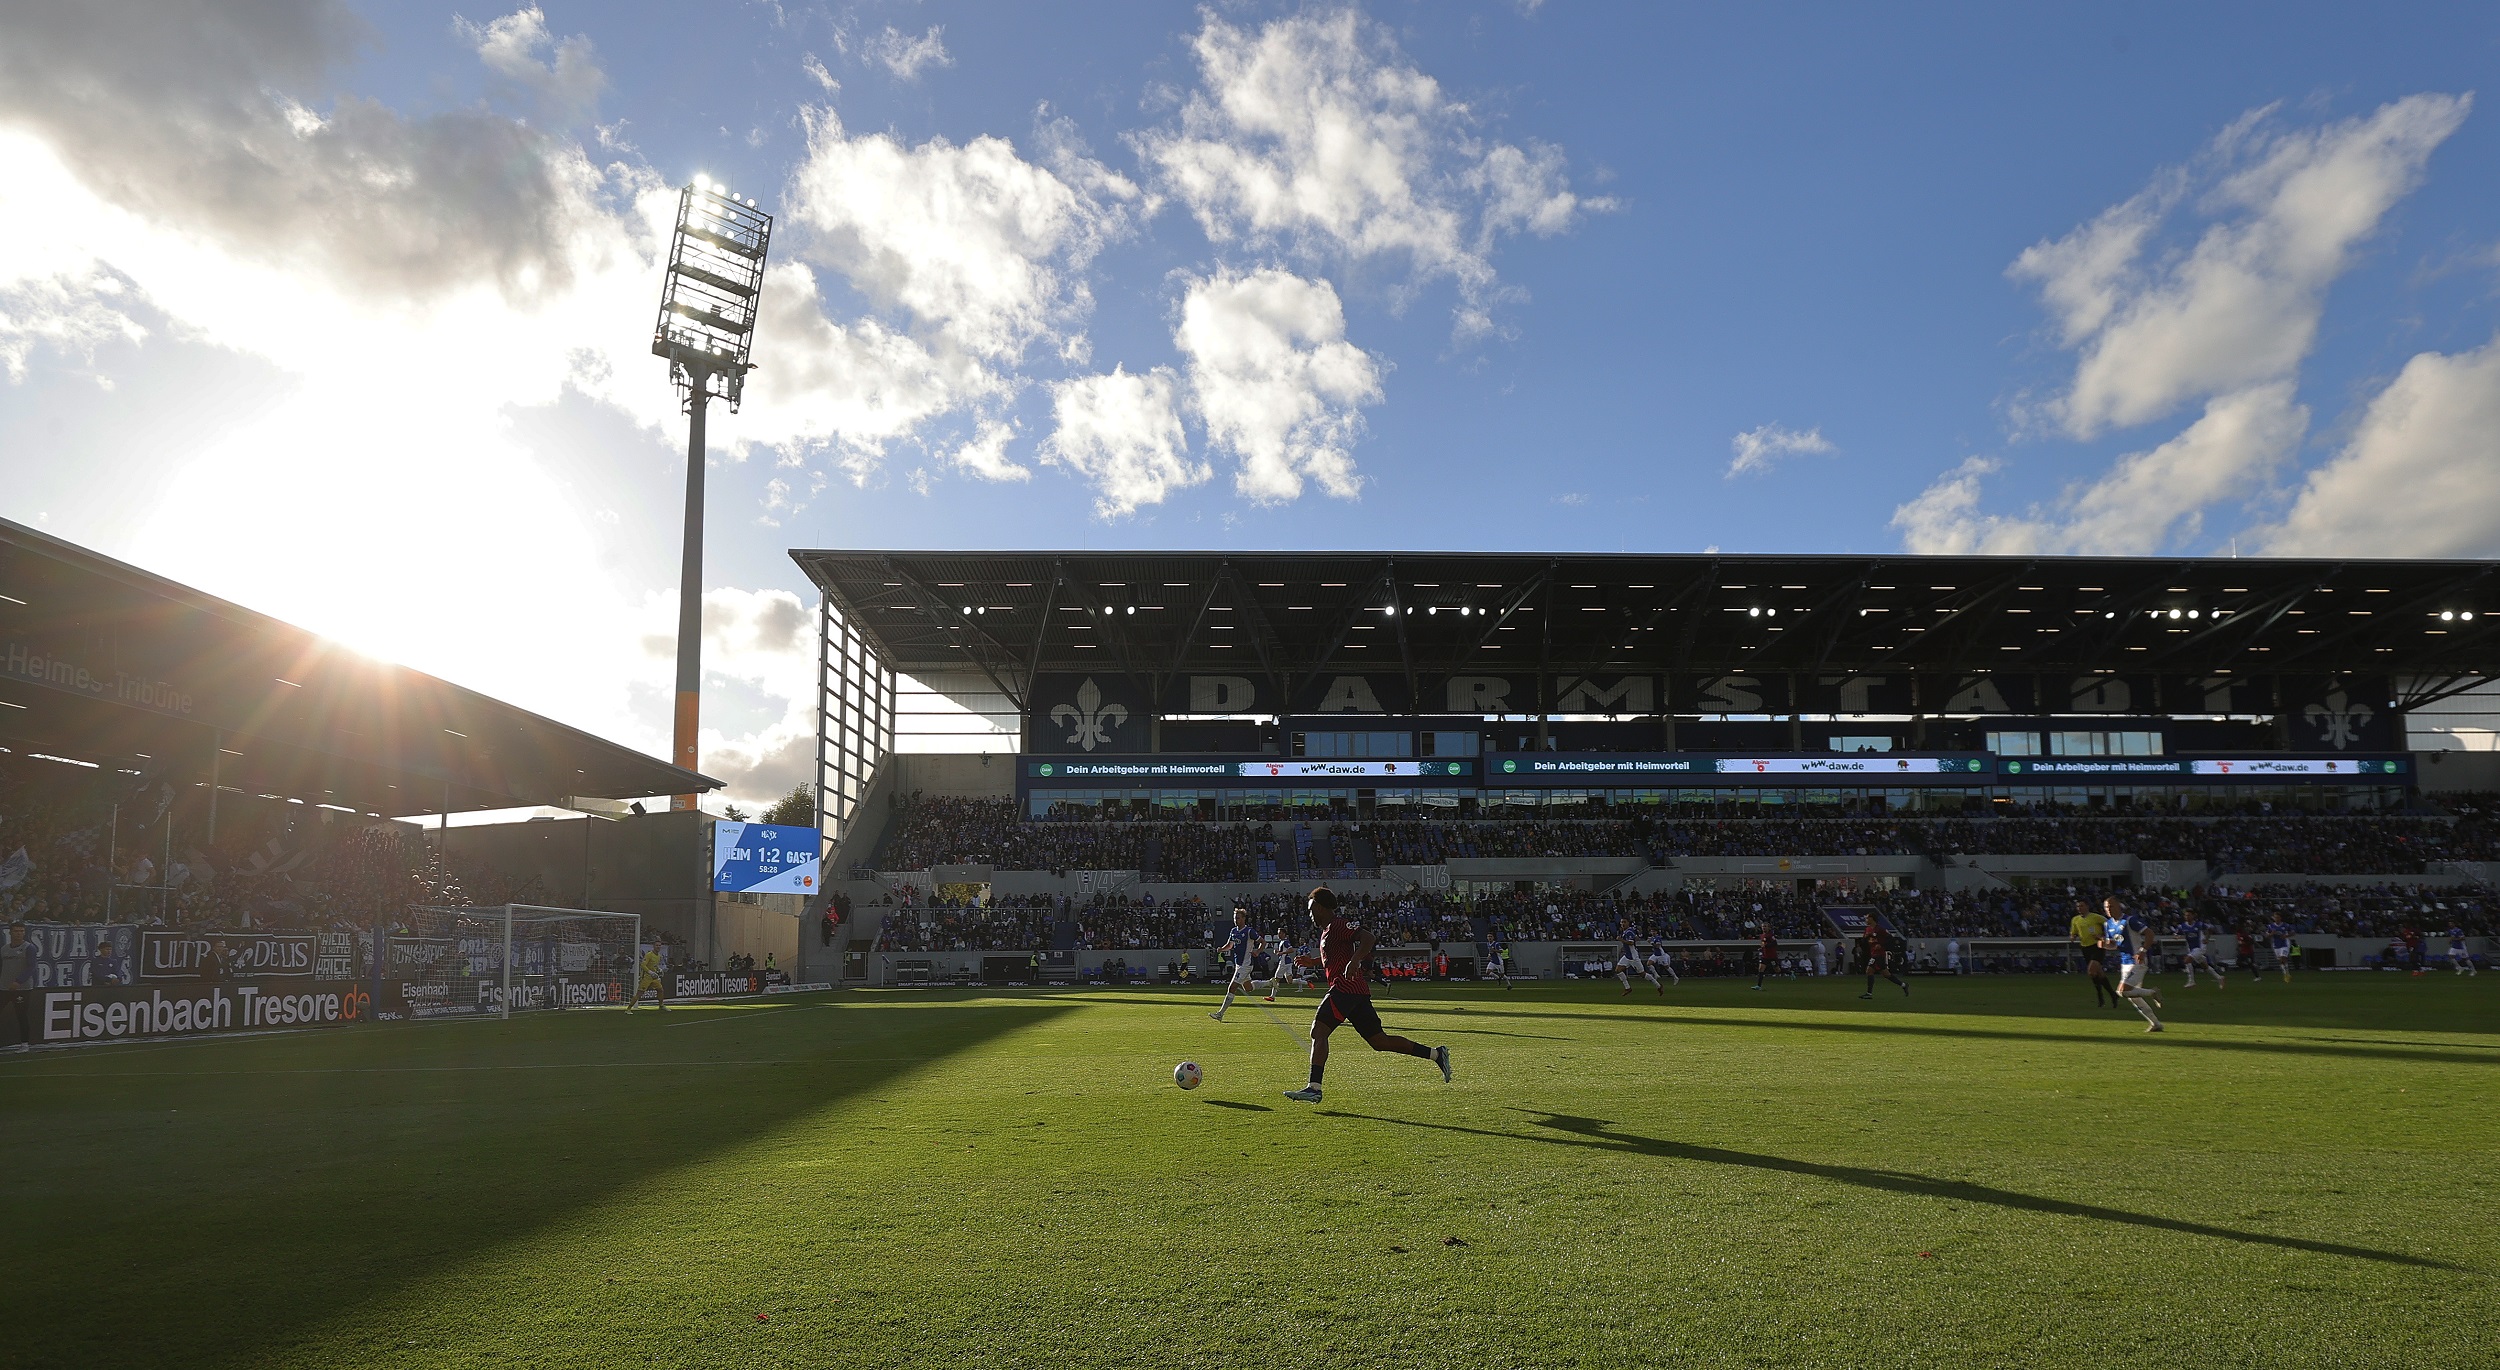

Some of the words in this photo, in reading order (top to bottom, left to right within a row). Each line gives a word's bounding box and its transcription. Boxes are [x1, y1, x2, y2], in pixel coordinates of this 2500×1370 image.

[1189, 675, 2248, 713] DARMSTADT
[1066, 765, 1089, 774] Dein
[1090, 765, 1149, 775] Arbeitgeber
[1151, 765, 1168, 773] mit
[1169, 765, 1225, 774] Heimvorteil
[1301, 763, 1366, 774] www.daw.de
[1534, 762, 1556, 770] Dein
[1558, 761, 1616, 772] Arbeitgeber
[1617, 761, 1634, 770] mit
[1635, 761, 1690, 770] Heimvorteil
[1801, 760, 1865, 771] www.daw.de
[2032, 763, 2054, 771] Dein
[2055, 763, 2110, 773] Arbeitgeber
[2111, 763, 2127, 771] mit
[2128, 762, 2180, 771] Heimvorteil
[2250, 761, 2309, 772] www.daw.de
[723, 847, 751, 861] HEIM
[759, 847, 780, 863] 1:2
[786, 851, 813, 864] GAST
[759, 865, 778, 874] 58:28
[1422, 865, 1450, 887] H6
[1076, 870, 1114, 893] W4
[402, 981, 449, 998] Eisenbach
[558, 977, 622, 1004] Tresore.de
[676, 973, 720, 997] Eisenbach
[720, 973, 758, 994] Tresore.de
[43, 987, 231, 1040] Eisenbach
